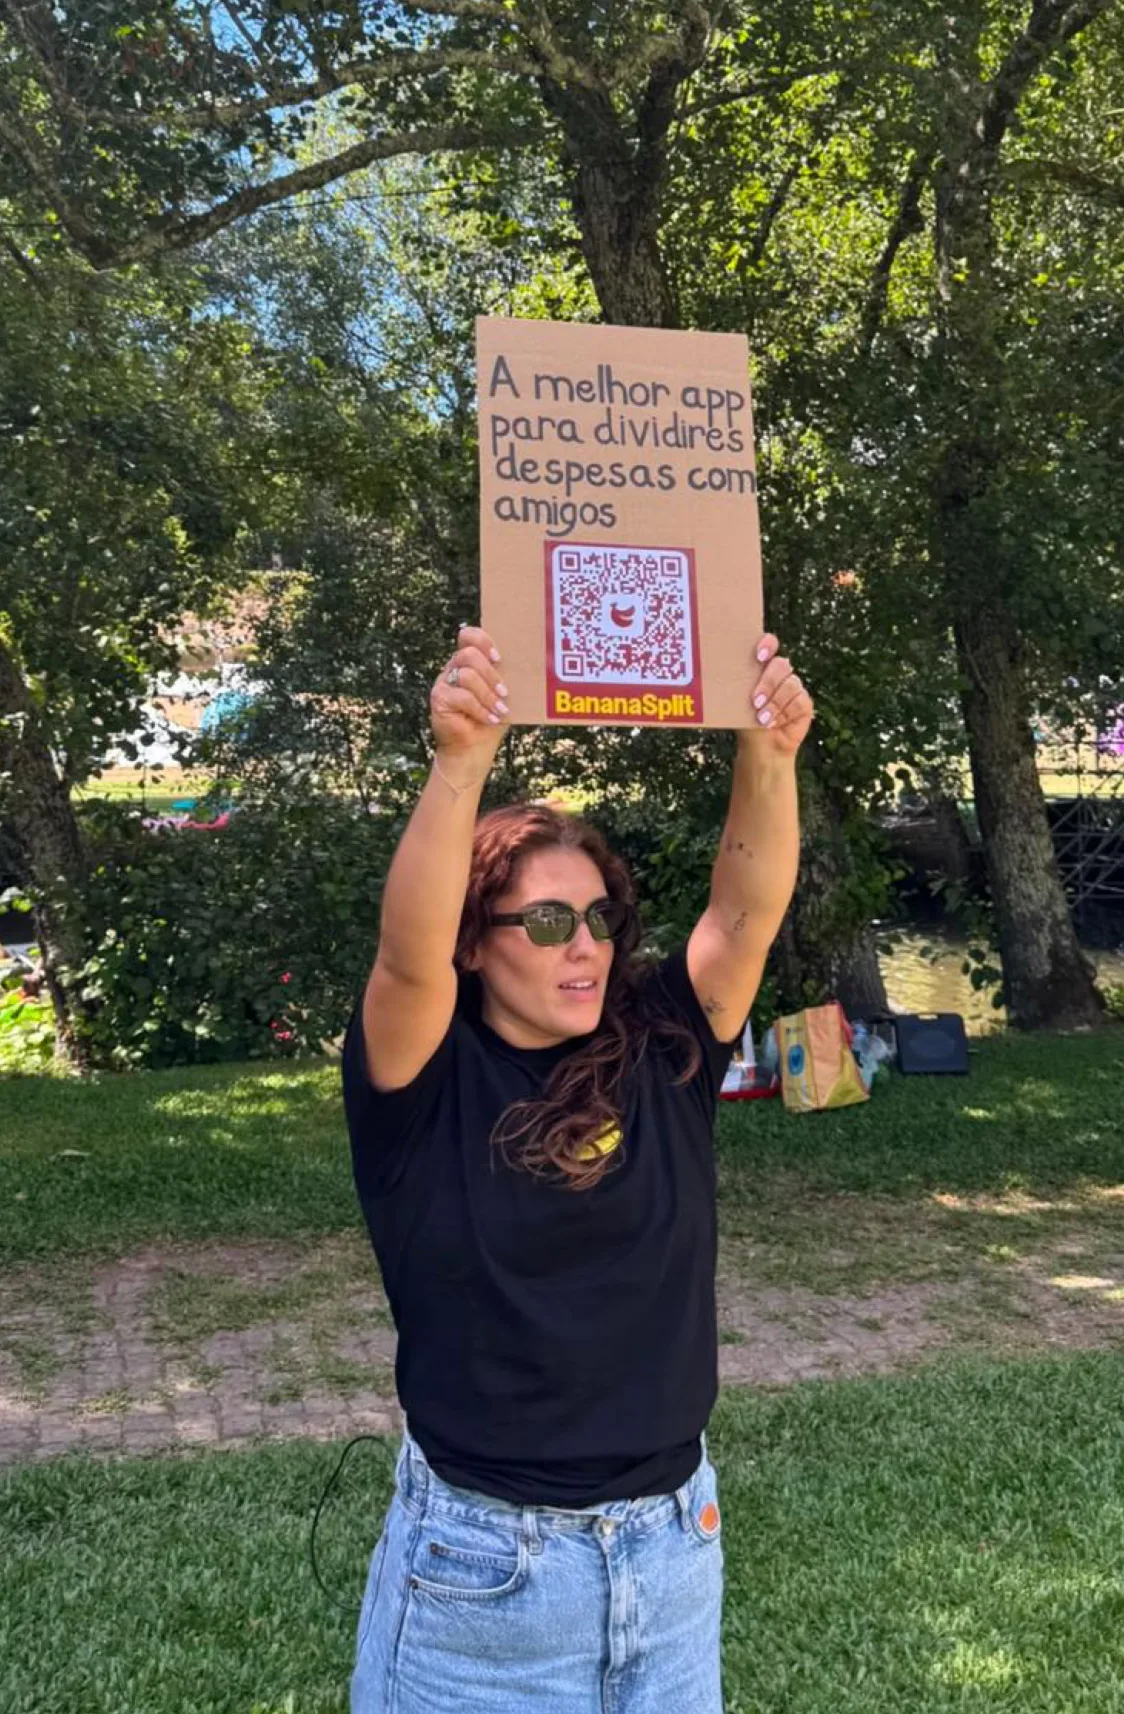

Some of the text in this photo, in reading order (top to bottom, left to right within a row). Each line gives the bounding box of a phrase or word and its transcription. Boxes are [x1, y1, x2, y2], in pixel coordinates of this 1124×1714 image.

[489, 355, 746, 429] A melhor app
[490, 407, 746, 456] para dividires
[495, 442, 756, 496] despesas com
[494, 495, 618, 537] amigos
[555, 690, 696, 720] BananaSplit
